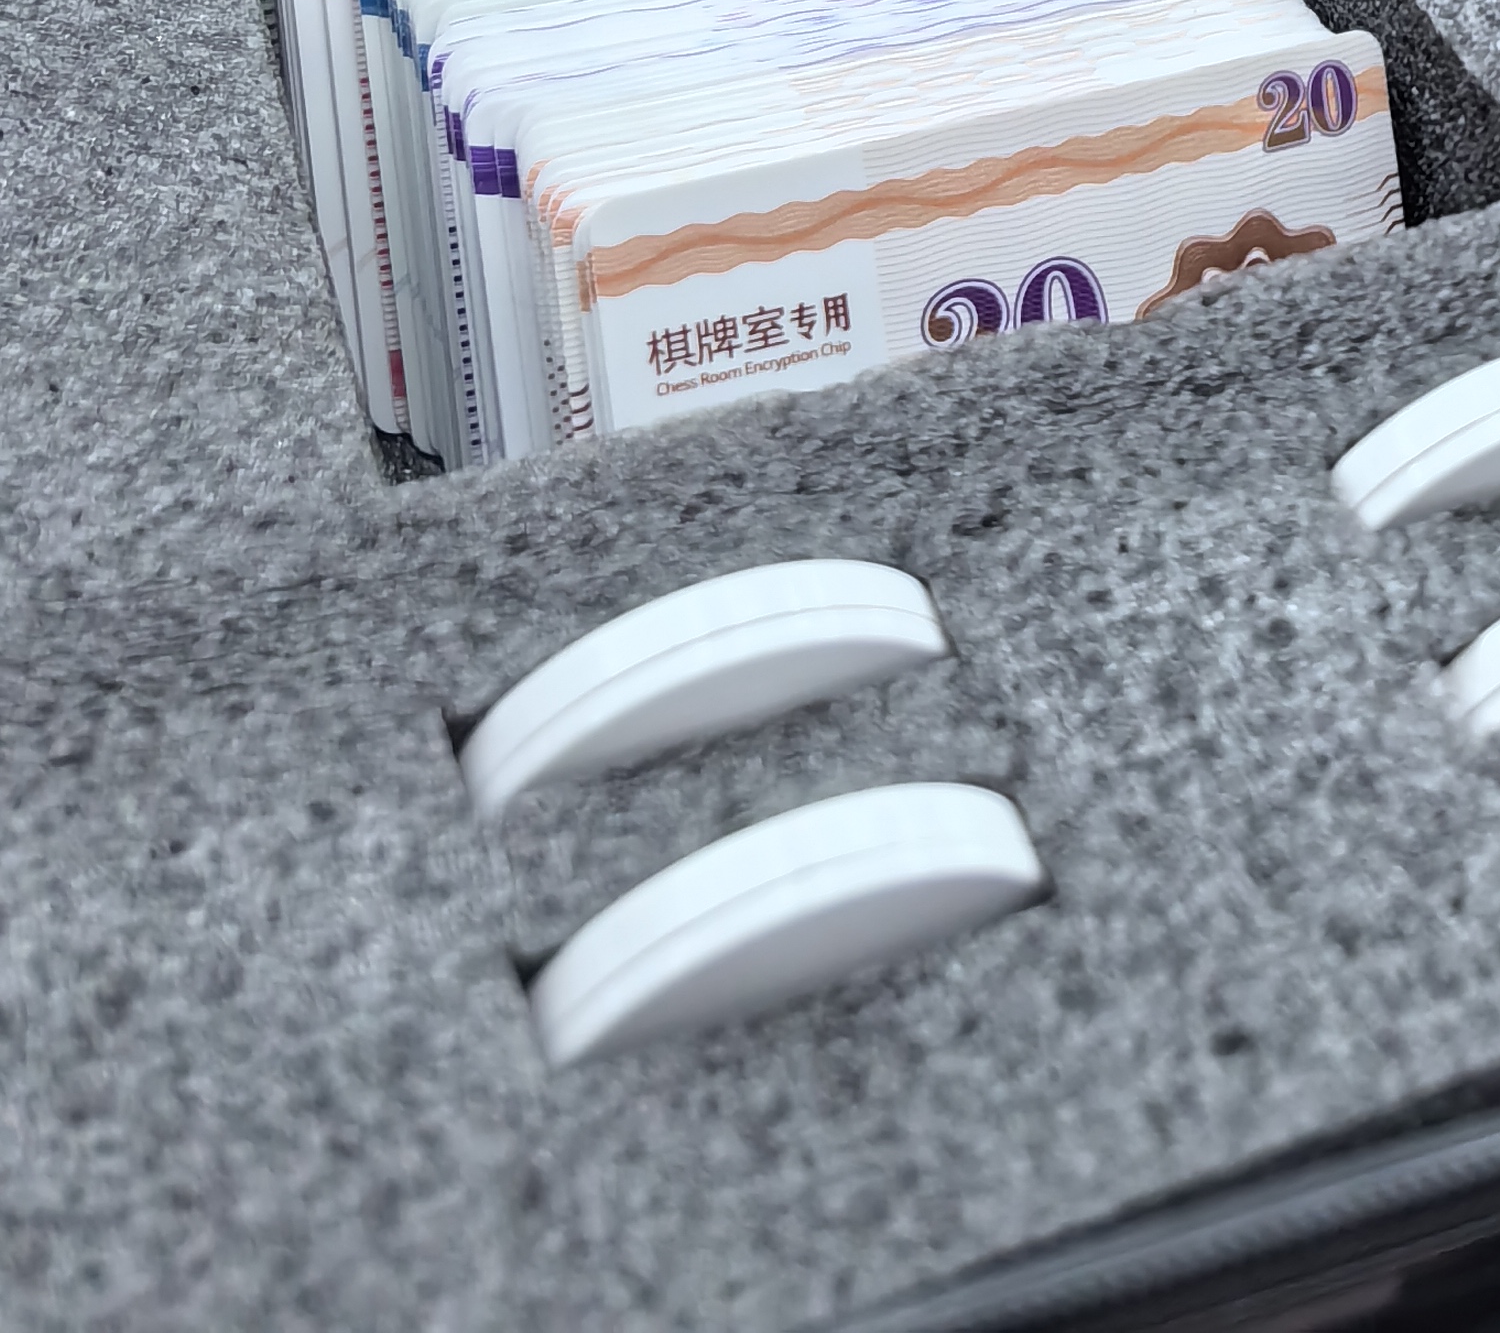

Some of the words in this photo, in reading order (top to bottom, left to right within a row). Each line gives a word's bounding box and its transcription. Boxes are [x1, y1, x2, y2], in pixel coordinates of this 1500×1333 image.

[1257, 60, 1358, 152] 20
[646, 292, 852, 377] 棋牌室专用
[656, 378, 699, 397] Chess
[700, 367, 743, 387] Room
[745, 350, 819, 376] Encryption
[820, 340, 852, 357] Chip
